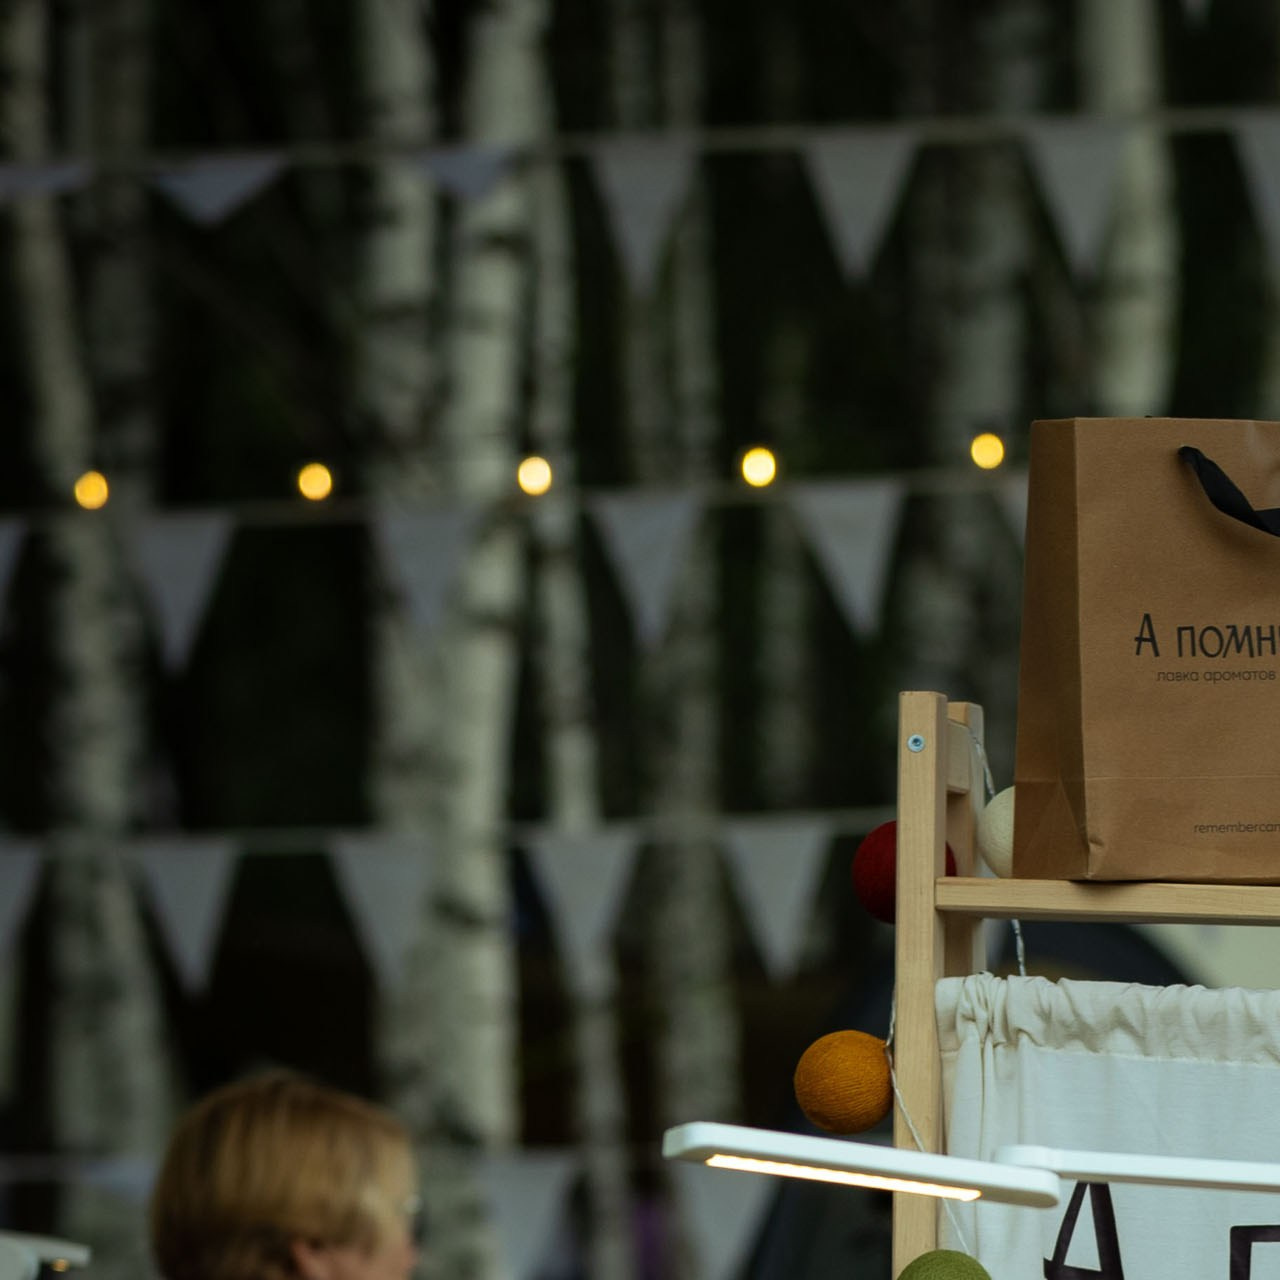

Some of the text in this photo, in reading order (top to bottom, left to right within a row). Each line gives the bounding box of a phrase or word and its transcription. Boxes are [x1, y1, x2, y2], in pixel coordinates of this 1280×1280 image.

[1134, 613, 1160, 657] А
[1155, 669, 1199, 682] лавка
[1203, 669, 1276, 684] ароматов
